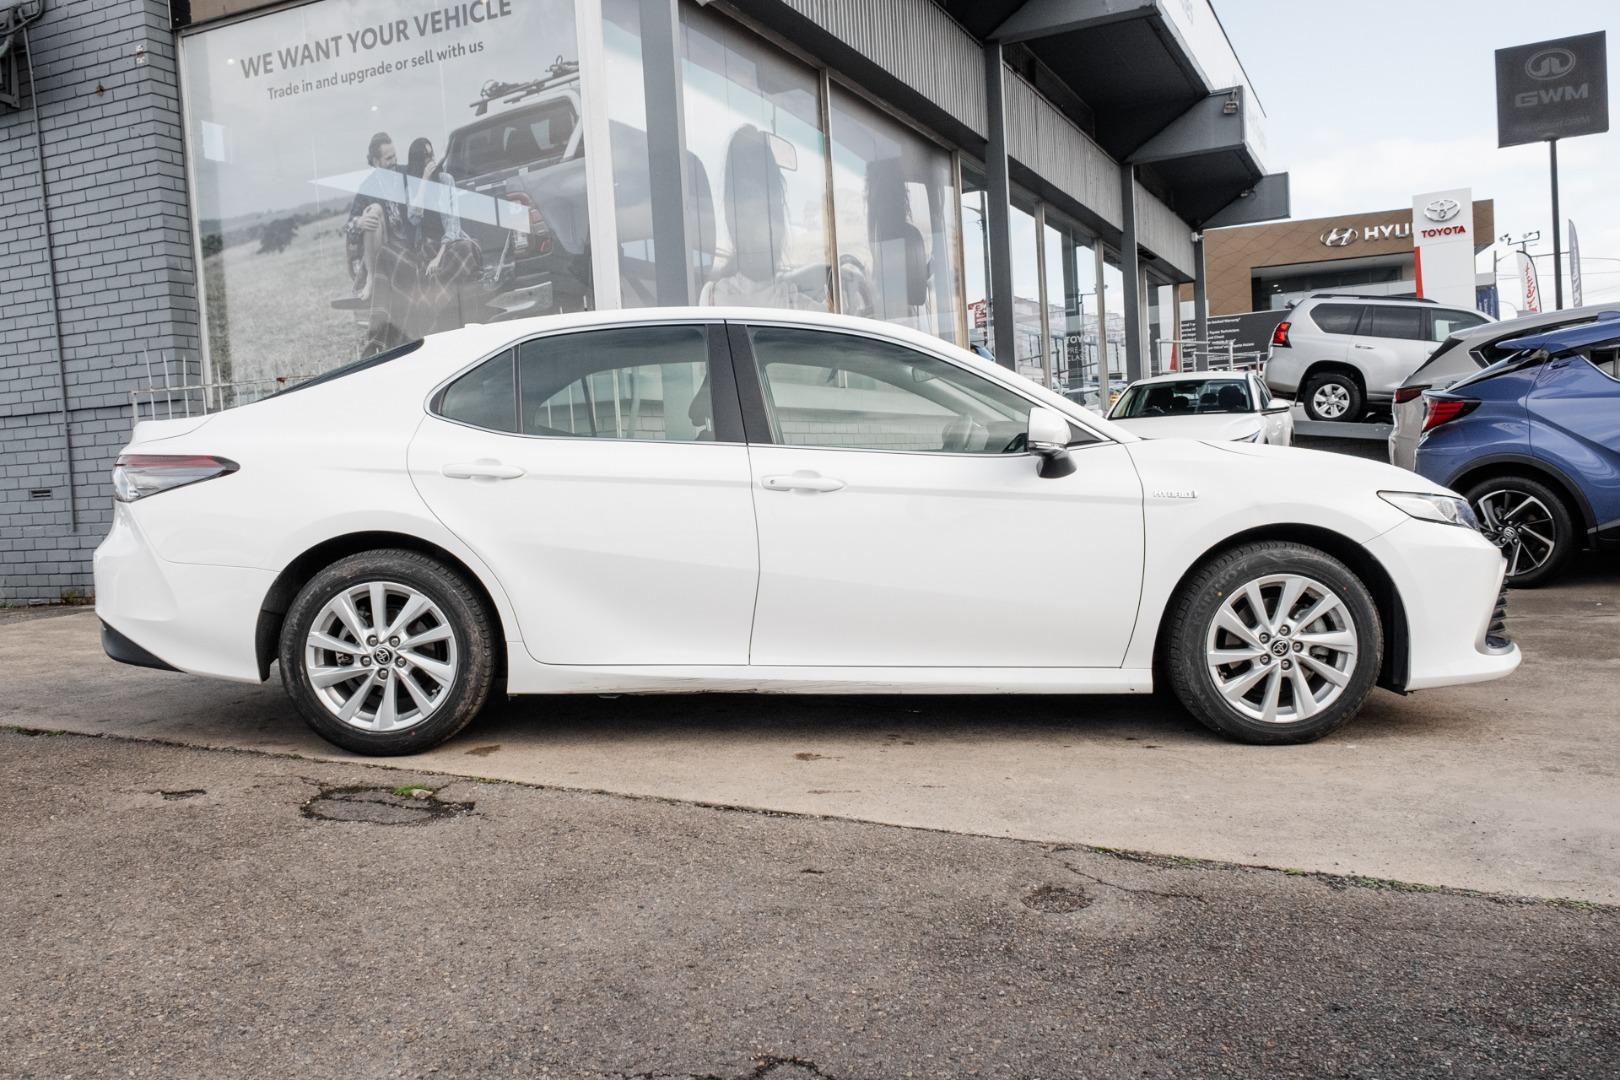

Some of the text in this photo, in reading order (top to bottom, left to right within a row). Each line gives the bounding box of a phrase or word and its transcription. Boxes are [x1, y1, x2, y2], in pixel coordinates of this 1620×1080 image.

[240, 0, 513, 80] WE WANT YOUR VEHICLE
[267, 40, 484, 100] Trade in and upgrade or sell with us
[1514, 83, 1590, 107] GWM
[1364, 222, 1414, 241] HYU
[1420, 224, 1466, 238] TOYOTA
